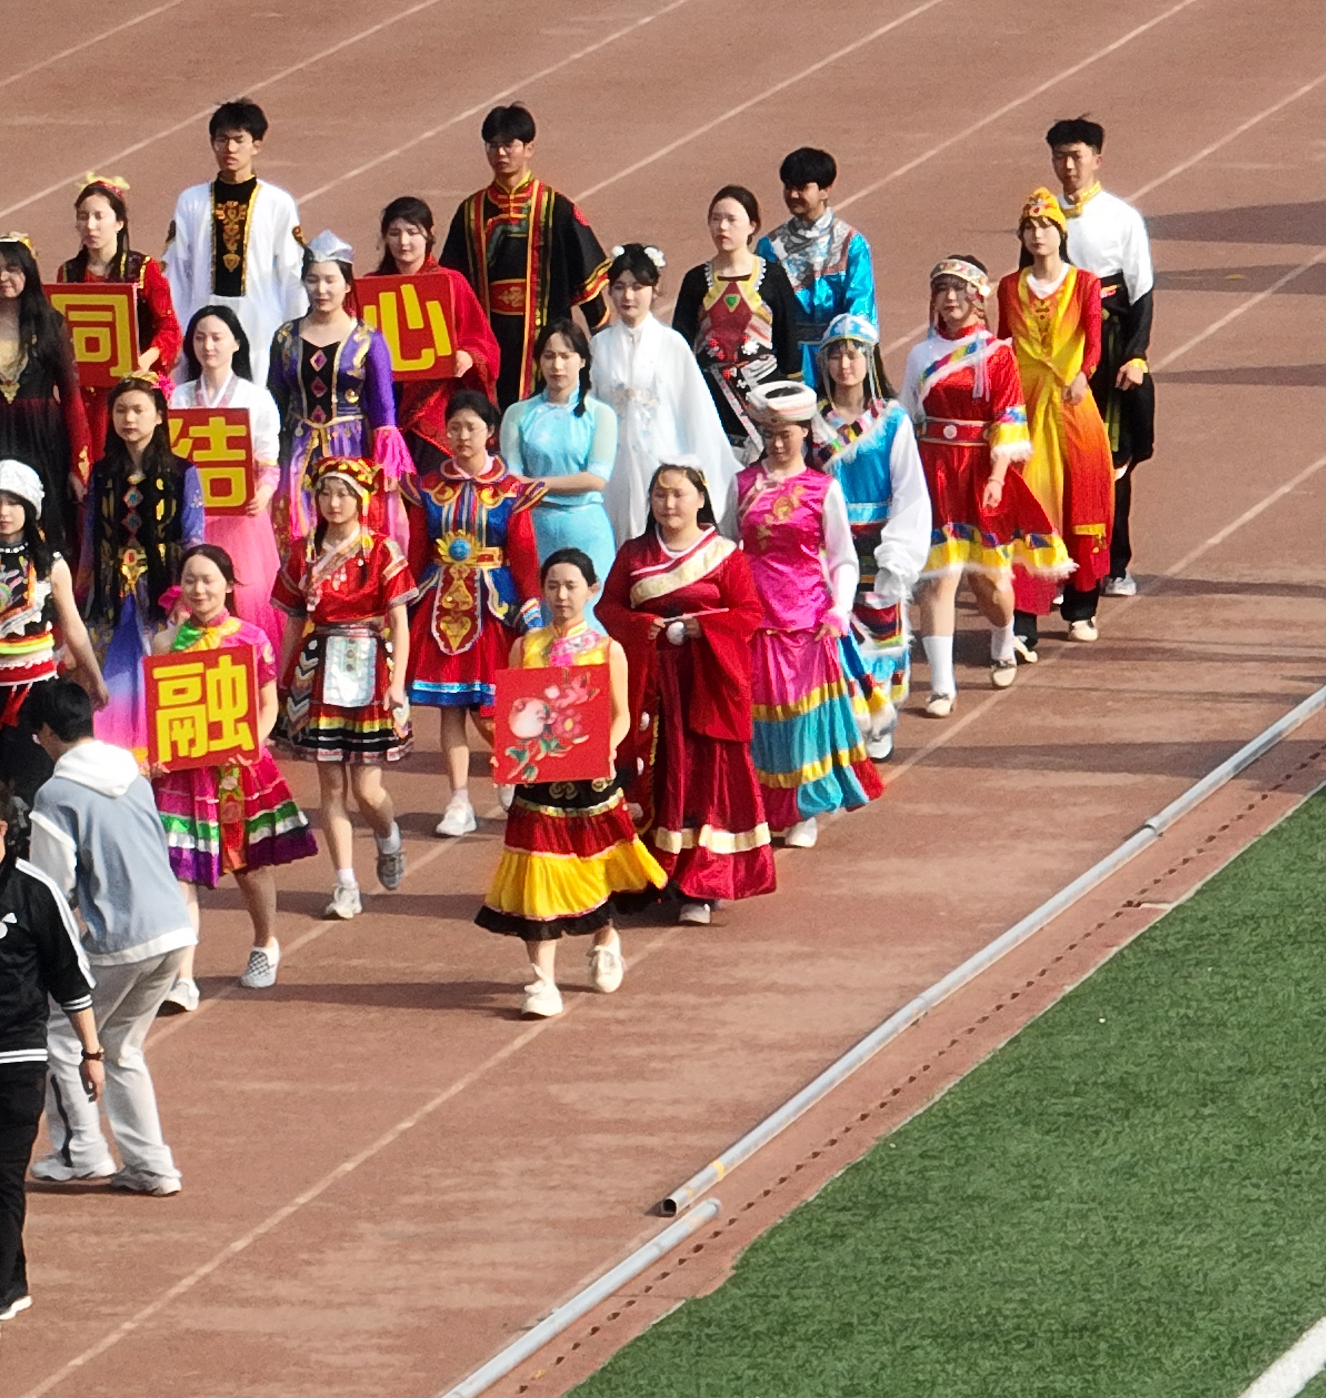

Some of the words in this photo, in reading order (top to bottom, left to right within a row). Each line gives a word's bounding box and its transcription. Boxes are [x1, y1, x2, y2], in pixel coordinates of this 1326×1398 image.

[51, 294, 132, 377] 同
[363, 284, 452, 372] 心
[169, 416, 247, 507] 结
[152, 655, 254, 763] 融
